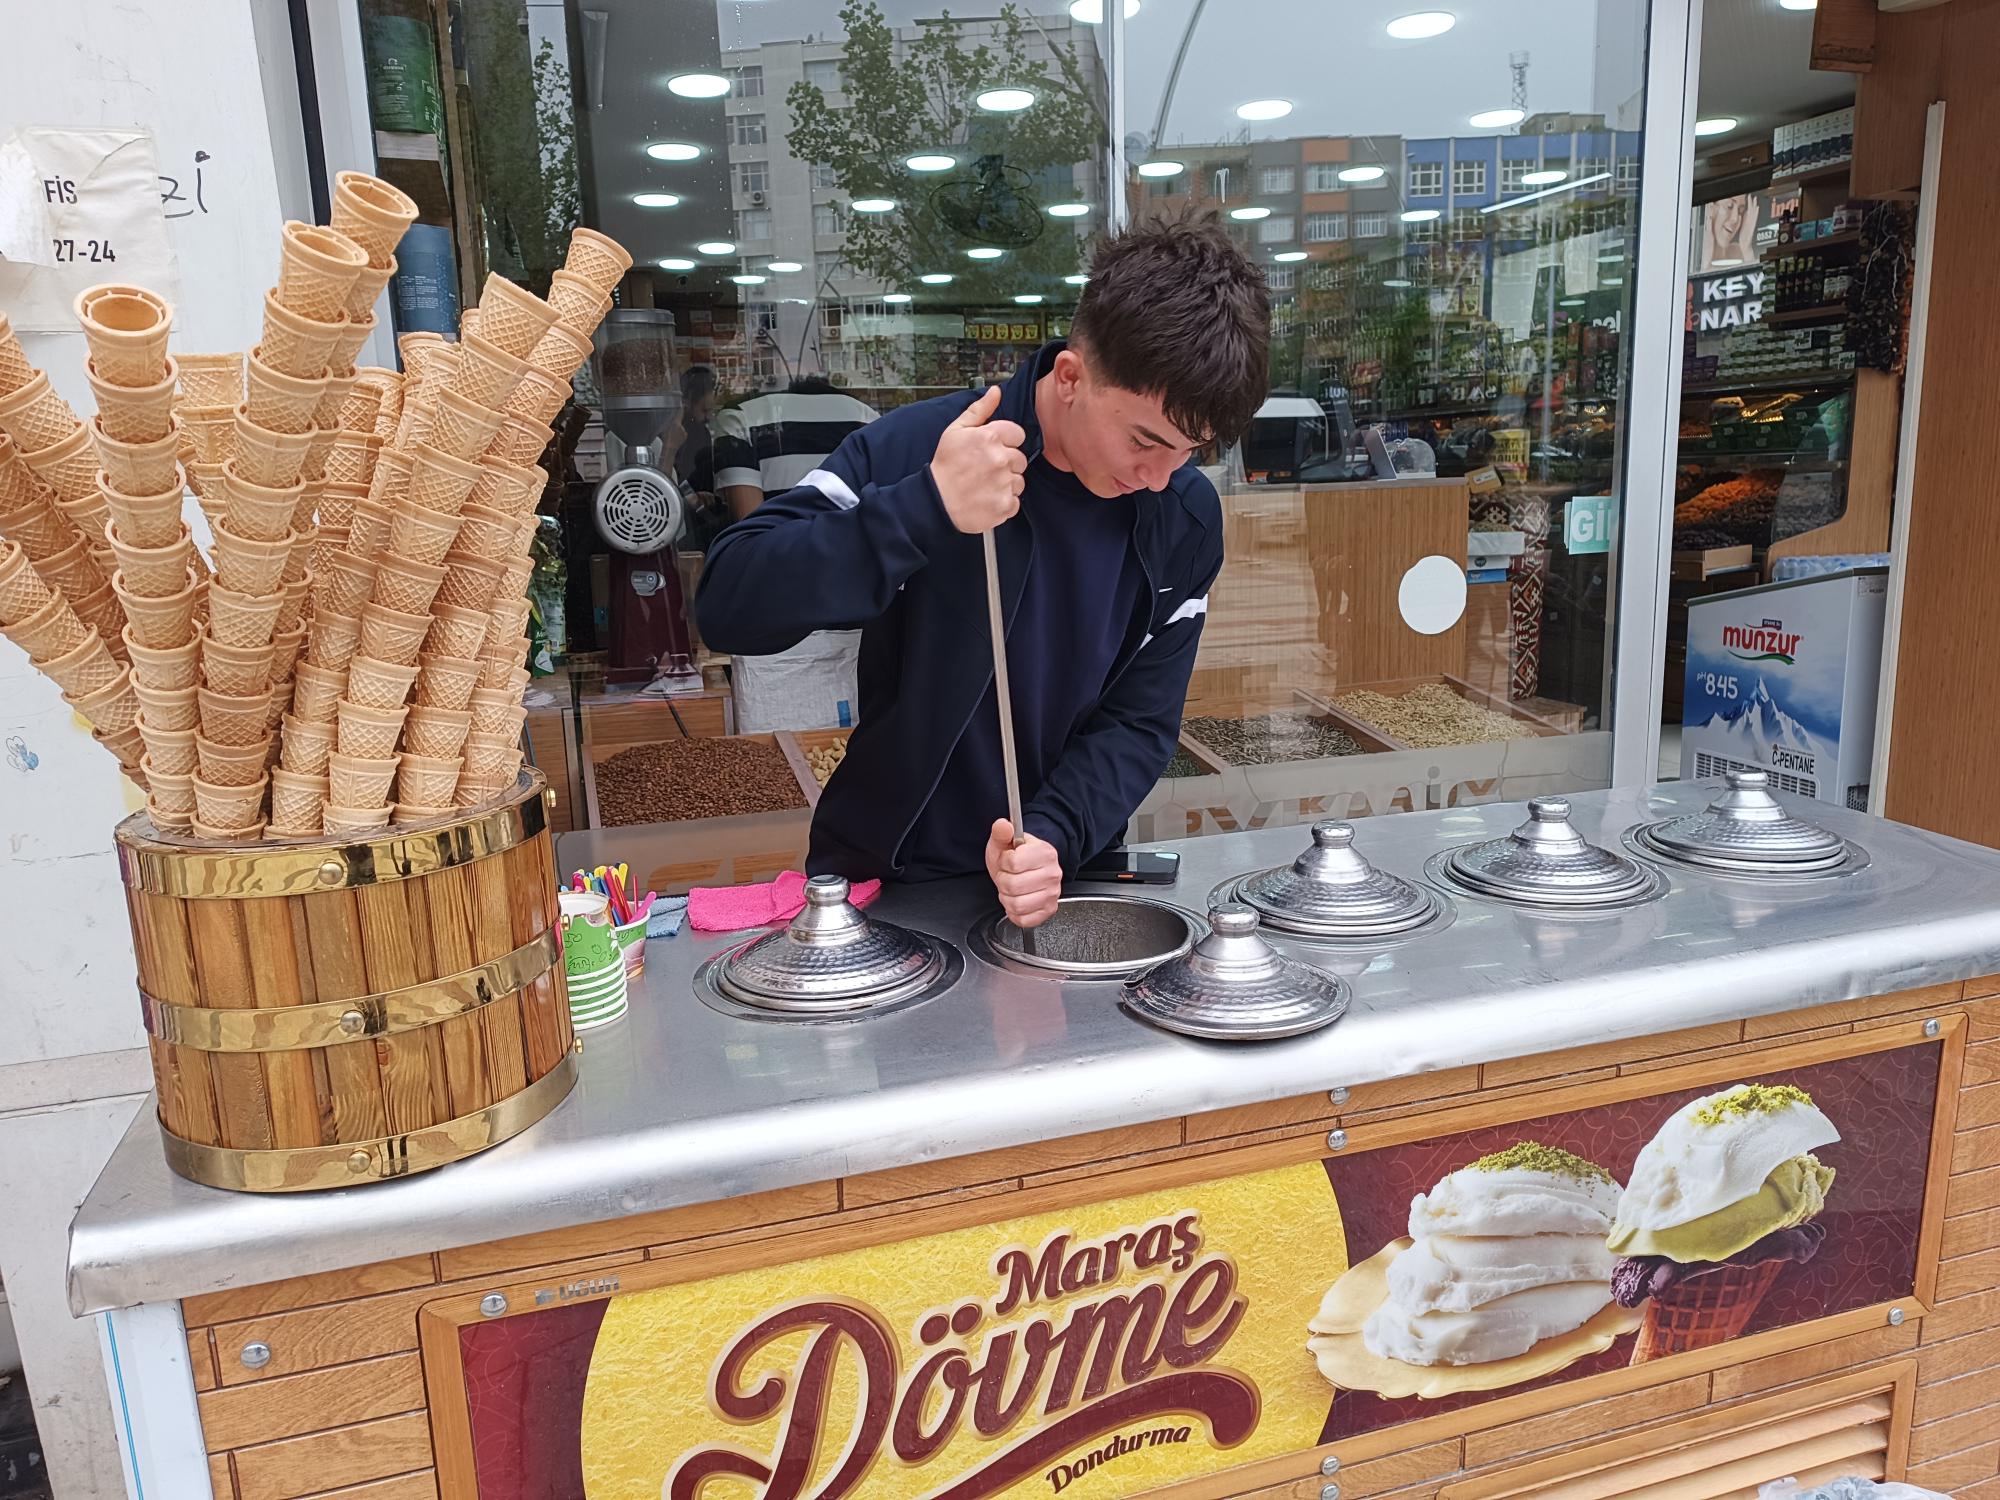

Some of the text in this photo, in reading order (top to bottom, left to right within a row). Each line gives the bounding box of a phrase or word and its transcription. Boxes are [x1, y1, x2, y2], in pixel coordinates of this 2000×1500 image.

[53, 239, 116, 263] 27-24
[1722, 625, 1801, 656] munzur
[1705, 672, 1738, 699] 8.45
[1772, 750, 1815, 775] C-PENTANE
[995, 1212, 1201, 1316] Maraş
[669, 1256, 1250, 1500] Dövme
[1046, 1424, 1193, 1495] Dondurma
